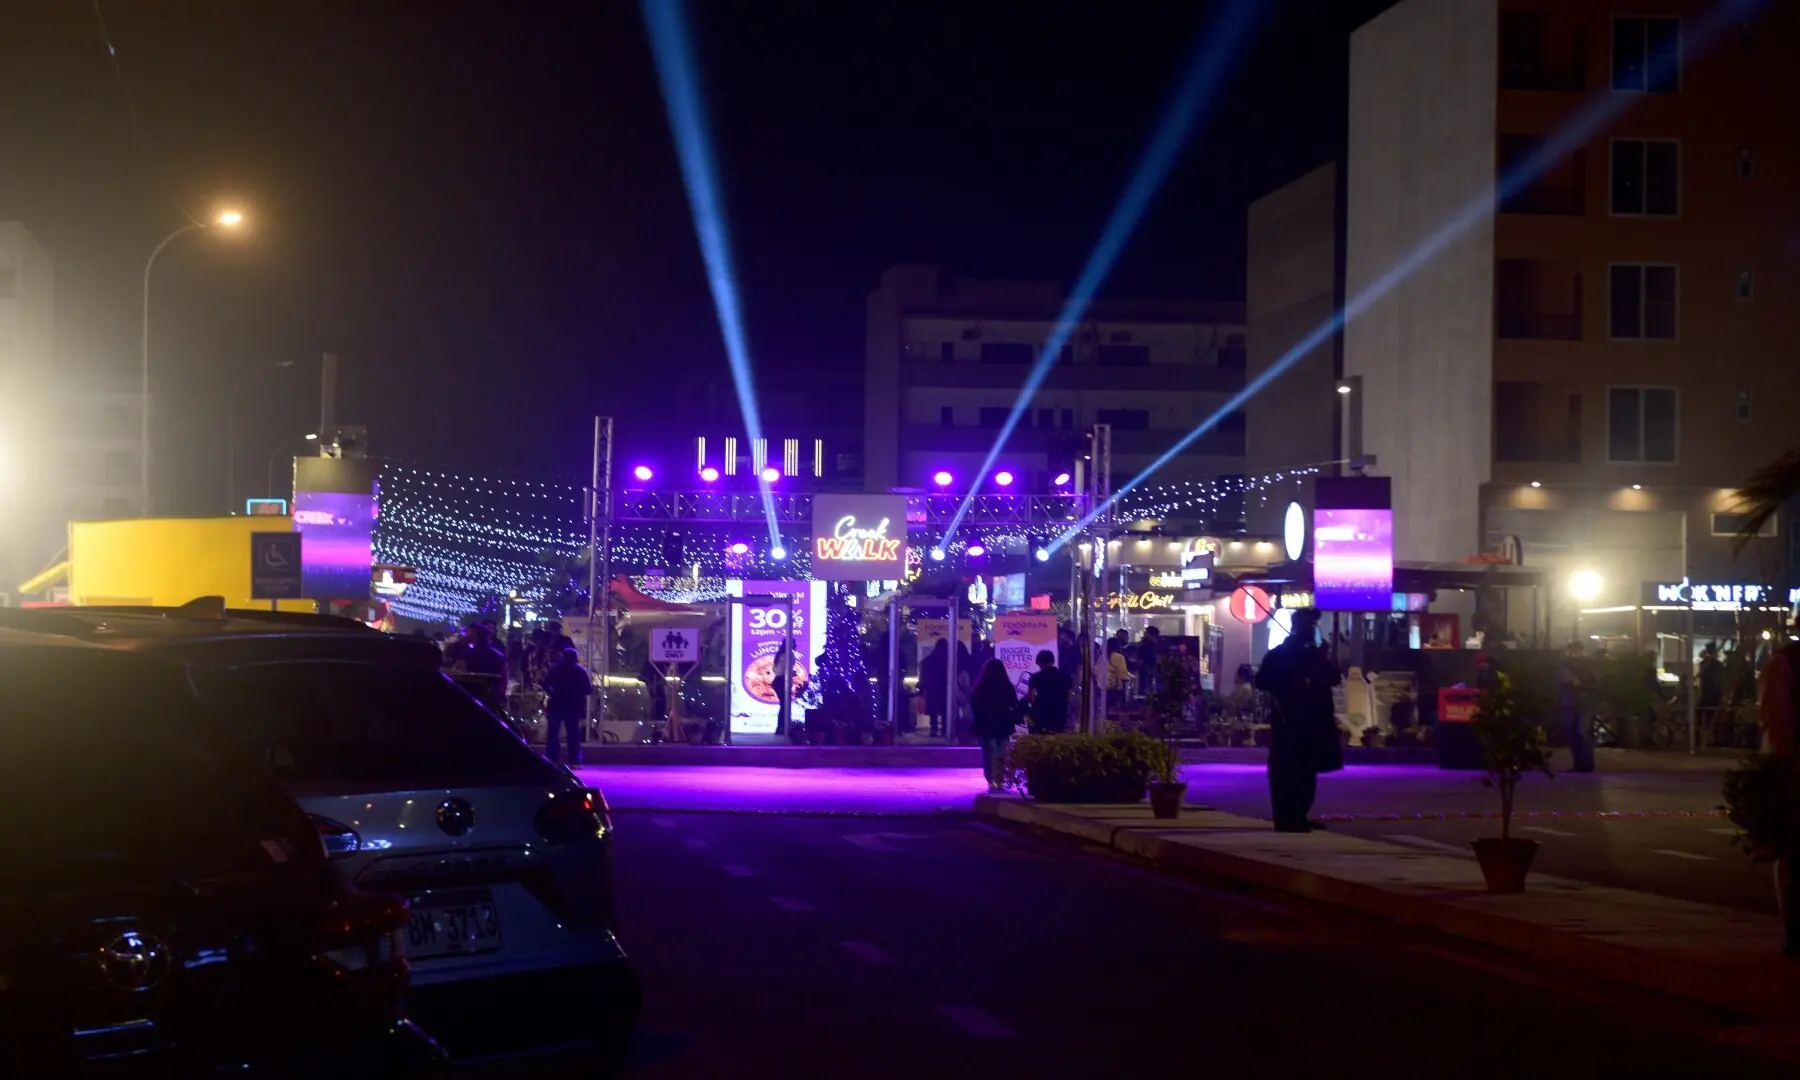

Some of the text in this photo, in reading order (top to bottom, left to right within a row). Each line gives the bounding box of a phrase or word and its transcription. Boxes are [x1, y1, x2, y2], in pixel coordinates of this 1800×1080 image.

[817, 538, 901, 561] WALK
[1658, 576, 1709, 602] WOK
[1000, 647, 1031, 655] BIGGER
